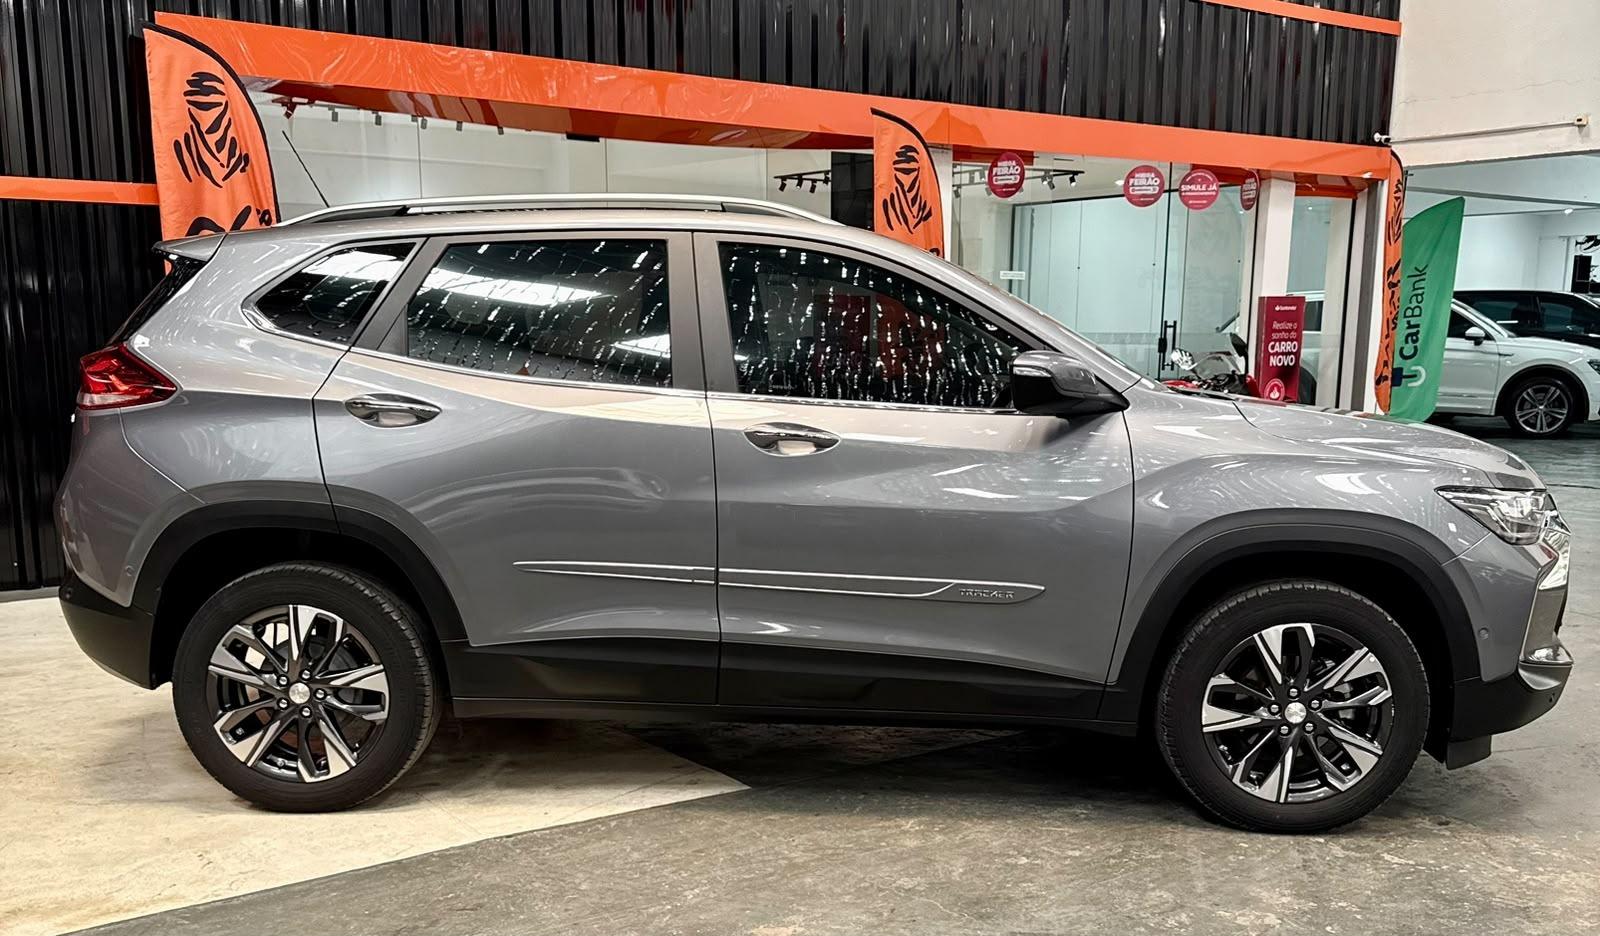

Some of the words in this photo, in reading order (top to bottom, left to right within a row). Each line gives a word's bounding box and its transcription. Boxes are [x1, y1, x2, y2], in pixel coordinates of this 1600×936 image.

[1207, 182, 1218, 191] JÁ
[1399, 264, 1429, 361] CarBank
[1272, 321, 1293, 330] Realize
[1271, 331, 1289, 340] sonho
[1268, 341, 1299, 354] CARRO
[1269, 355, 1296, 367] NOVO
[960, 588, 1014, 599] TRACKER
